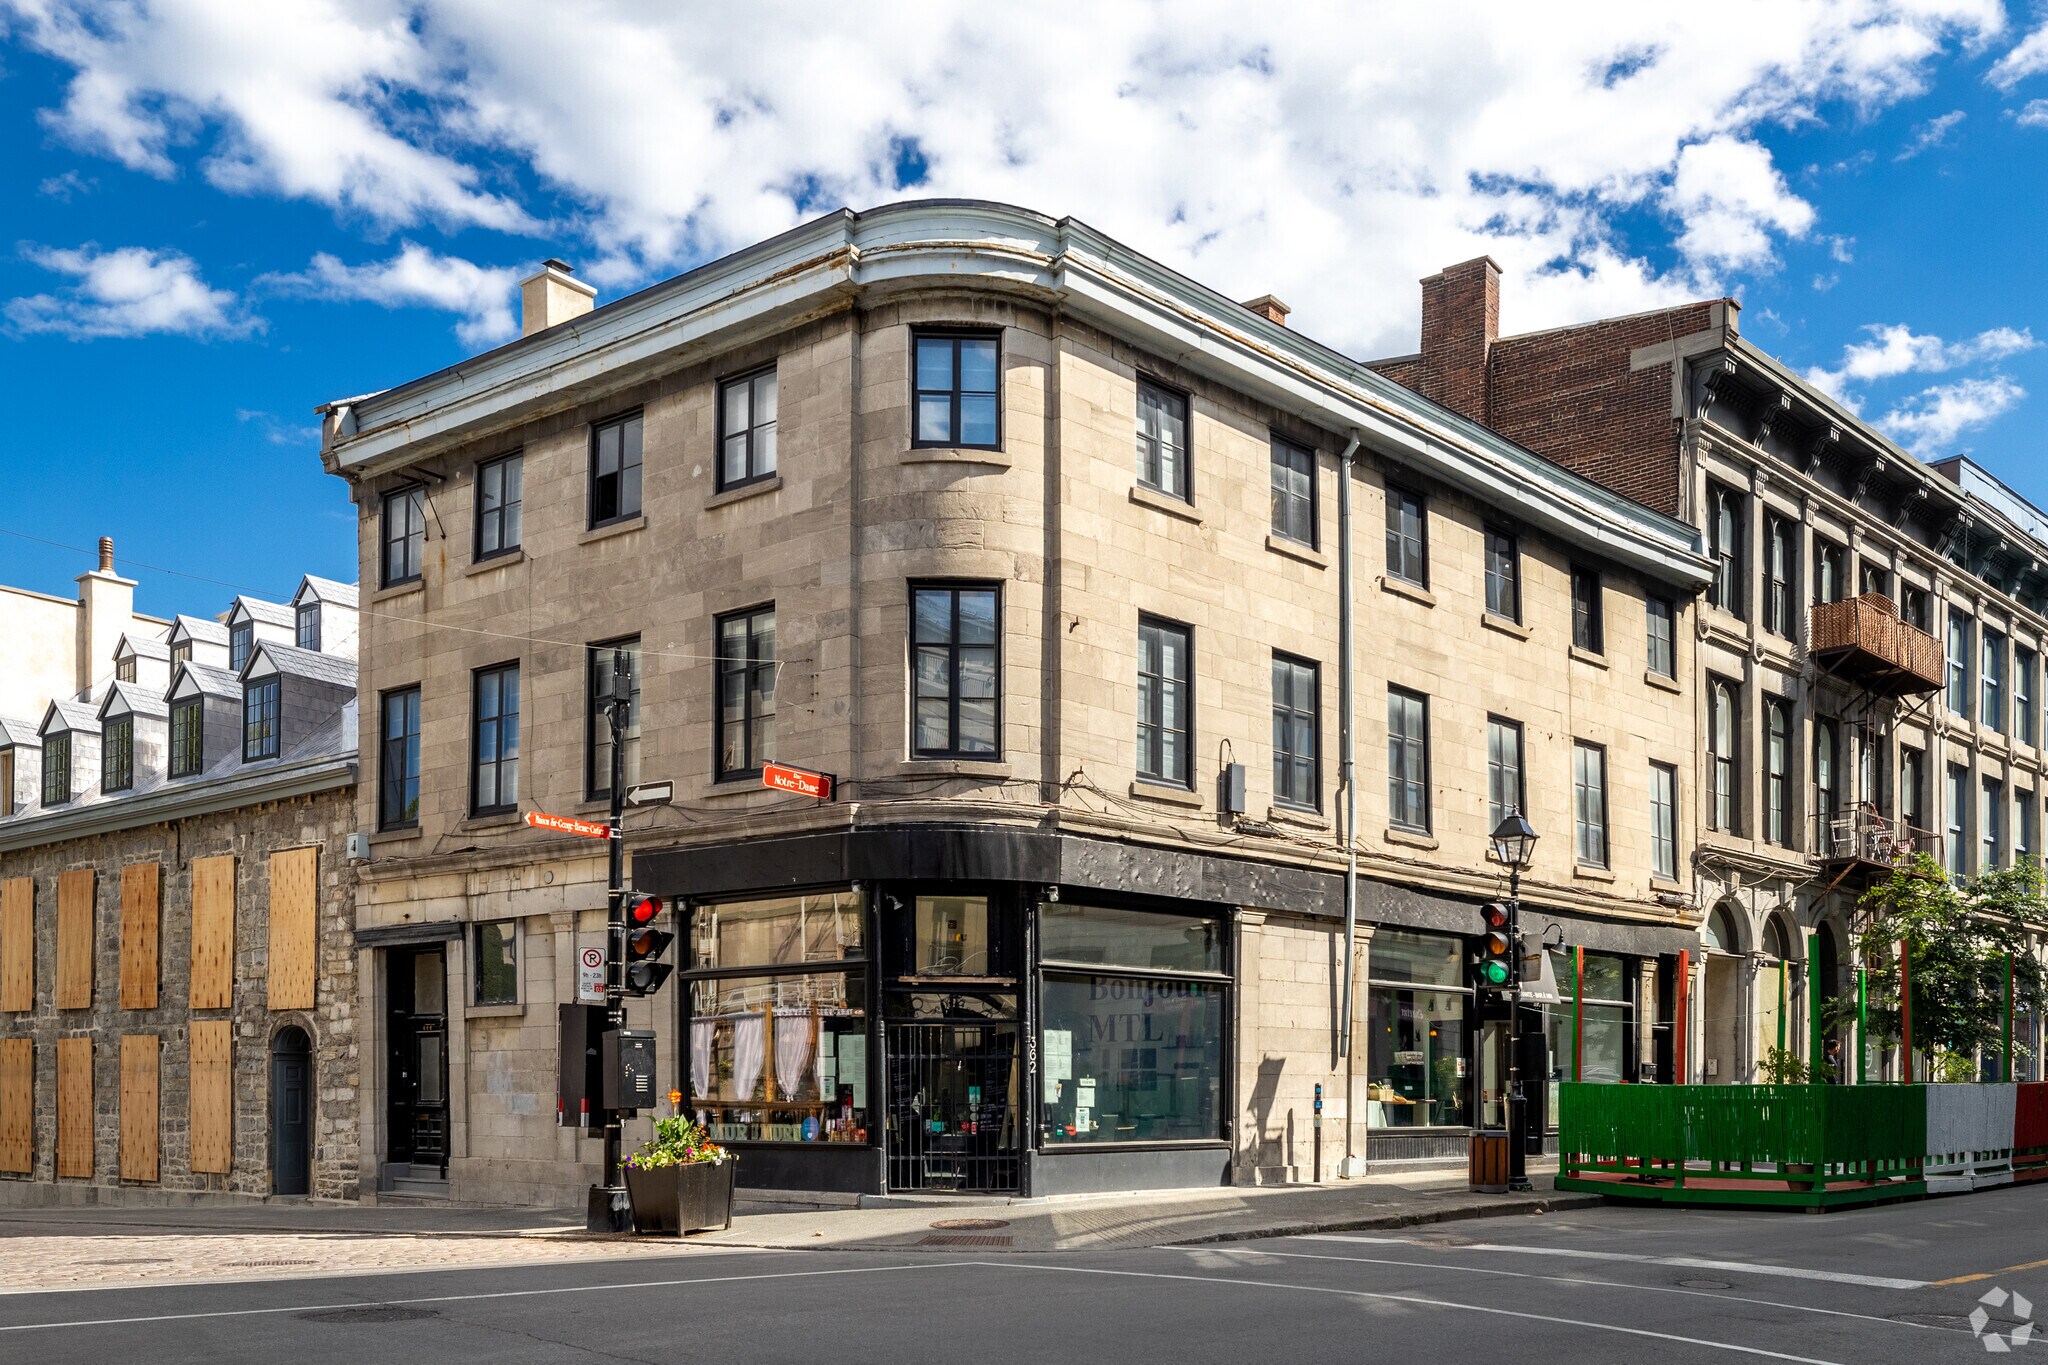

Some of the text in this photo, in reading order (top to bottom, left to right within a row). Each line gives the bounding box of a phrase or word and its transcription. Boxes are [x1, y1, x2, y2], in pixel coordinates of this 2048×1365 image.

[774, 774, 819, 793] Notre-Dame
[1088, 1013, 1164, 1042] MTL
[1029, 1036, 1037, 1073] 362
